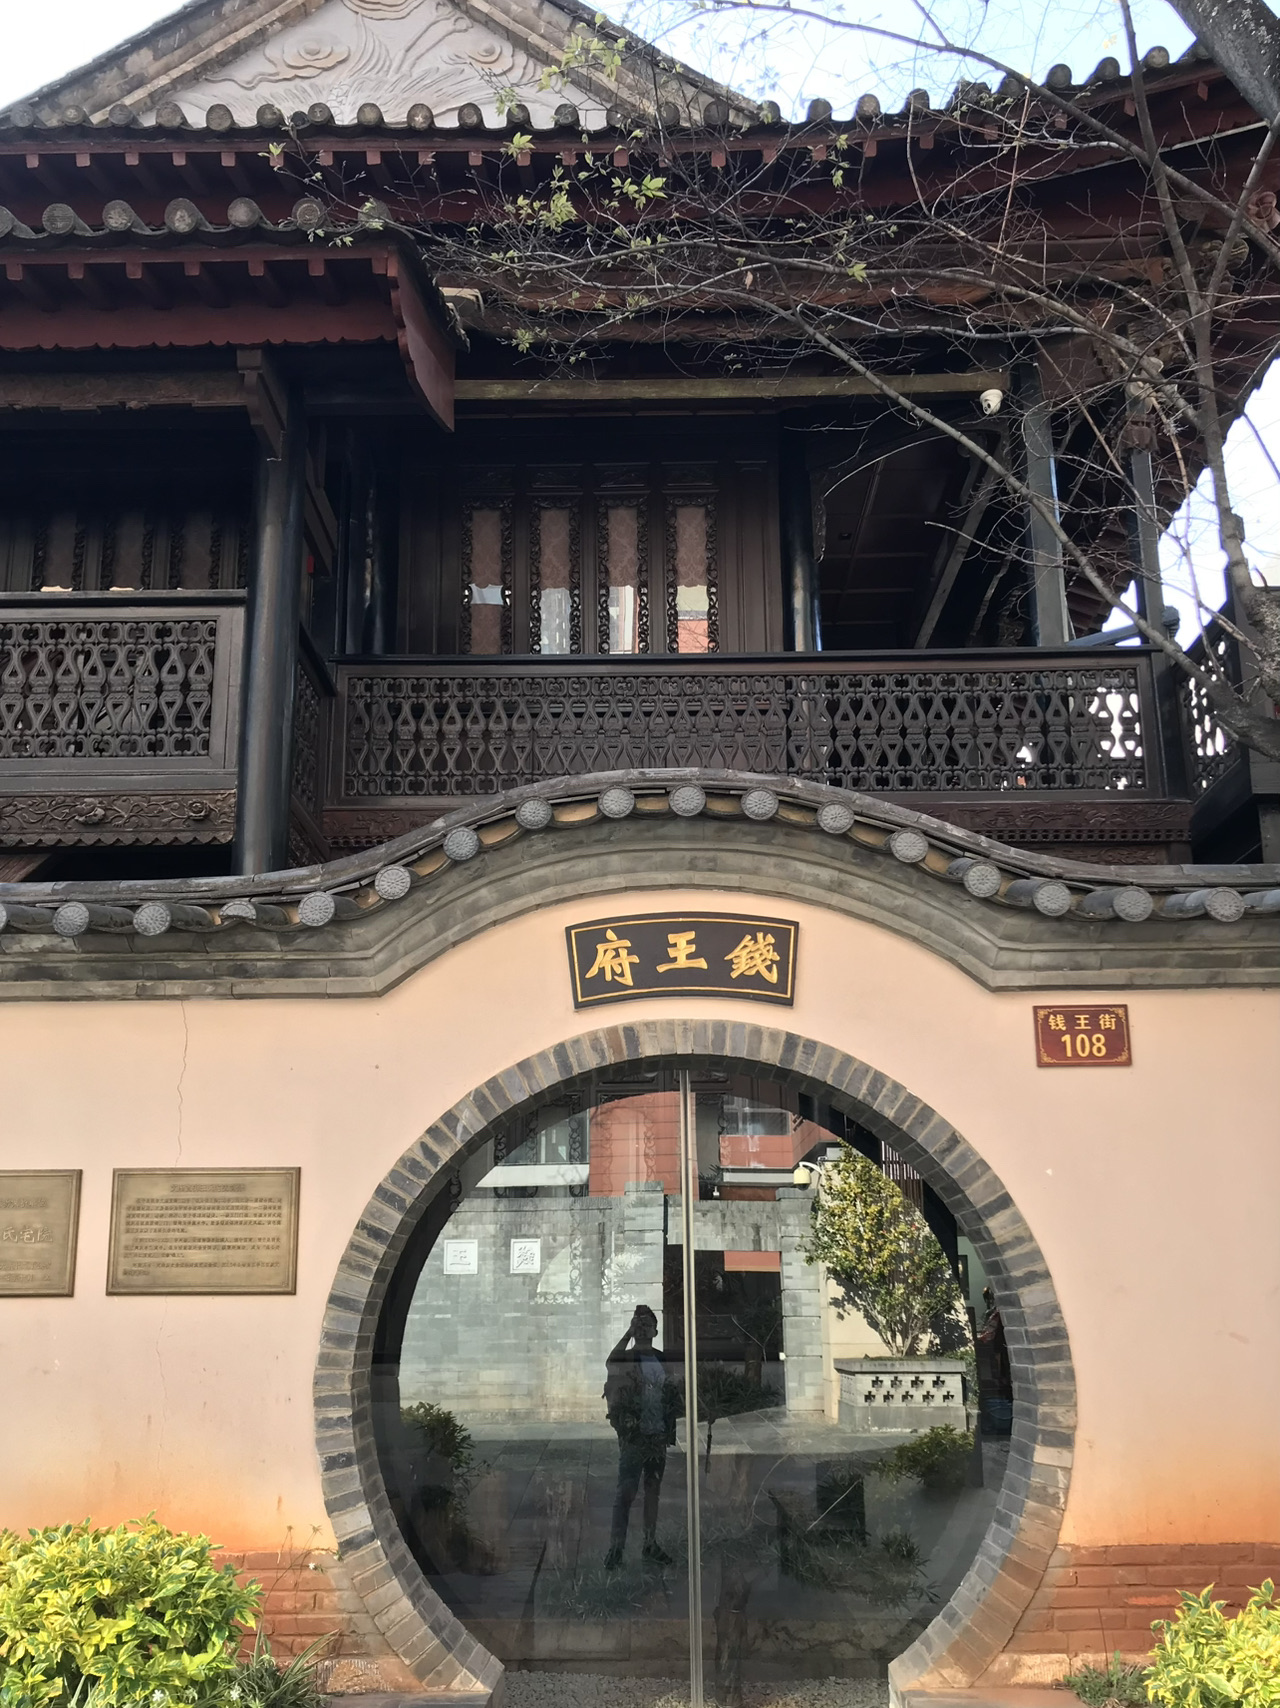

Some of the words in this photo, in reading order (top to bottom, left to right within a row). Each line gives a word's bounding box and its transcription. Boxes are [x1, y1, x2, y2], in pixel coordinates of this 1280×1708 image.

[1048, 1013, 1117, 1031] 钱王街
[1061, 1033, 1107, 1058] 108
